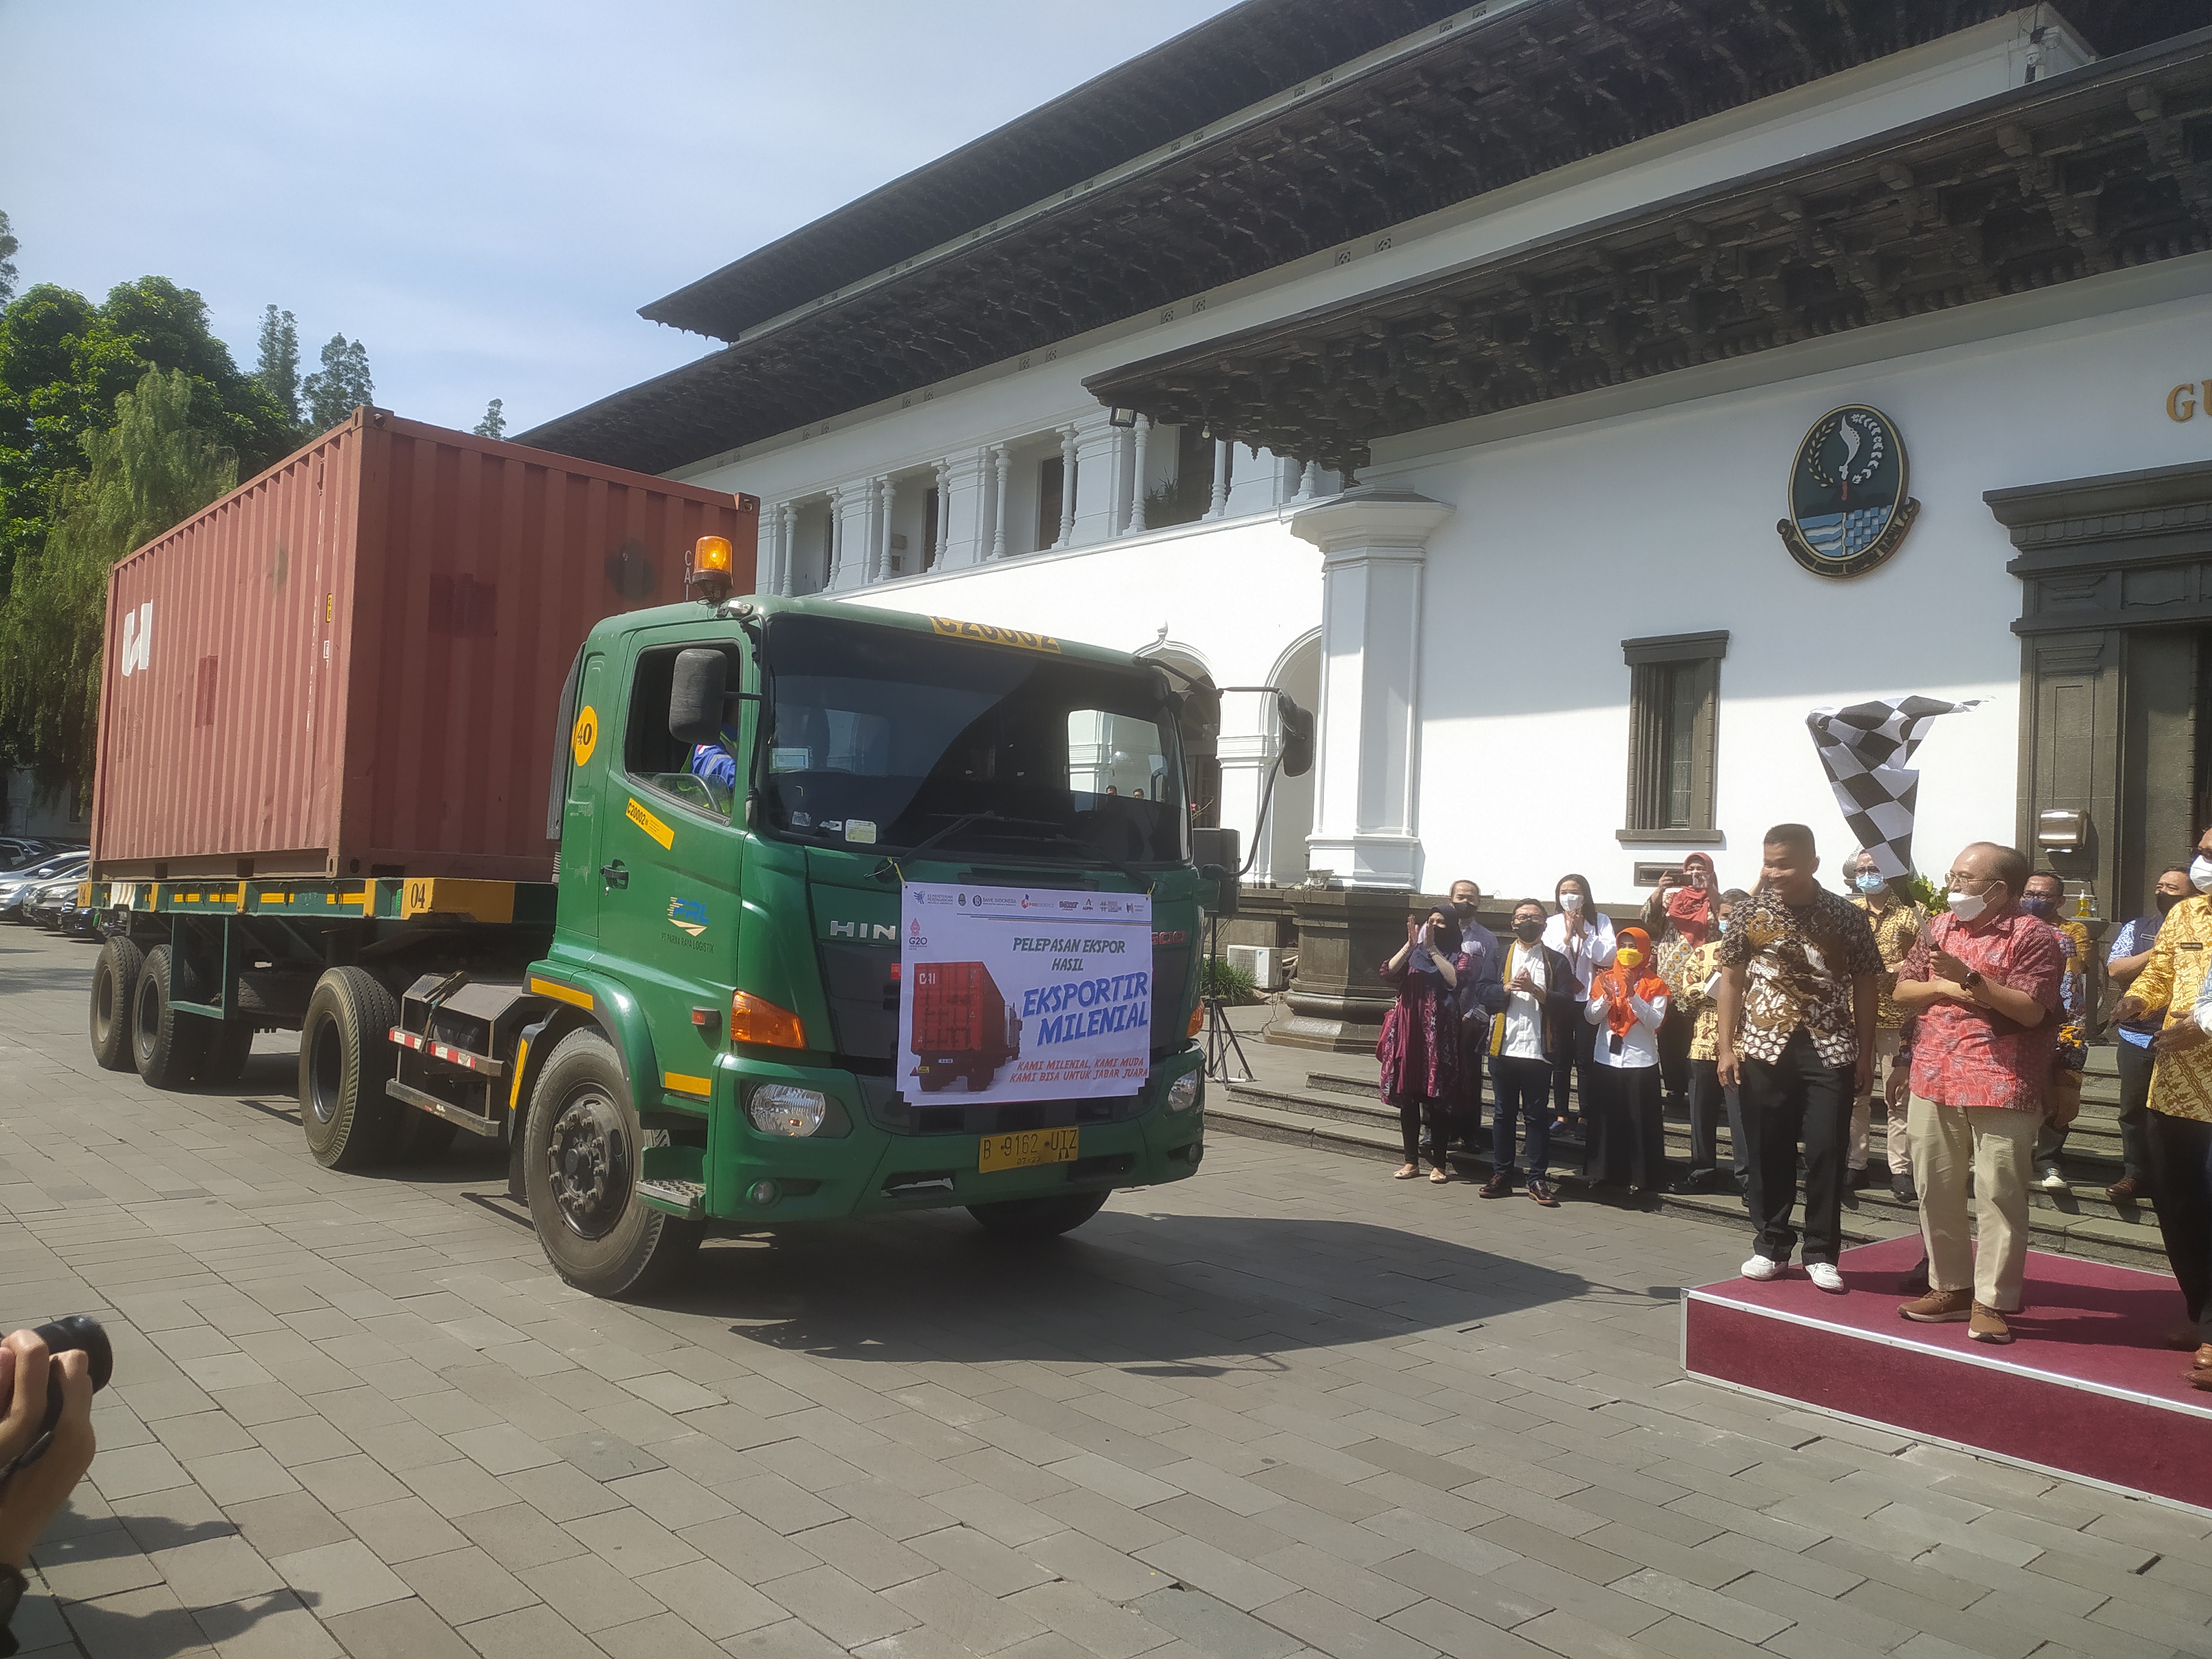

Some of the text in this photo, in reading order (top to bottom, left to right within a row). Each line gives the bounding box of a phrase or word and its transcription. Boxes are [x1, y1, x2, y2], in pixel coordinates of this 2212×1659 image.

[577, 723, 592, 745] 40
[627, 802, 646, 826] C20002
[411, 883, 425, 909] 04
[830, 921, 896, 940] HIN
[681, 937, 692, 949] RAYA
[692, 941, 714, 953] LOGISTIK
[909, 937, 928, 945] G20
[1013, 937, 1125, 953] PELEPASAN EKSPOR
[1051, 958, 1084, 971] HASIL
[1023, 972, 1147, 1018] EKSPORTIR
[1037, 1001, 1147, 1046] MILENIAL
[1017, 1057, 1144, 1071] KAMI MILENIAL, KAMI MUDA
[1009, 1068, 1148, 1083] KAMI BISA UNTUK JABAR JUARA
[983, 1129, 1078, 1160] B 9162 UIZ
